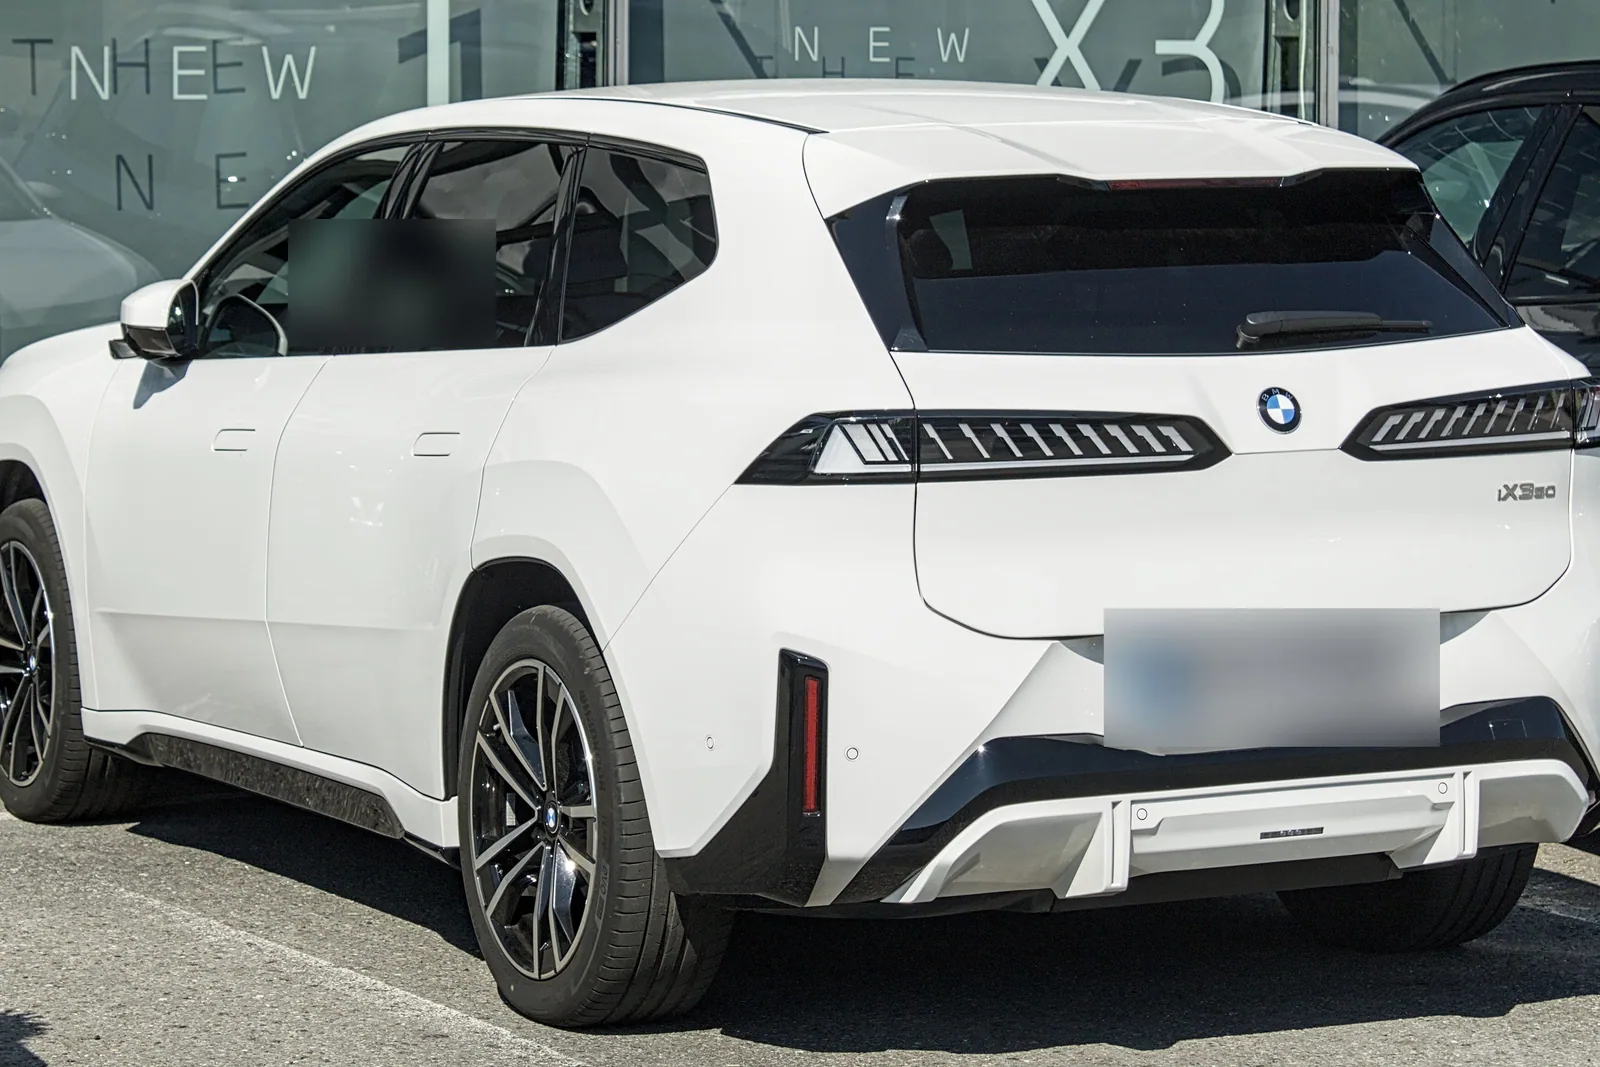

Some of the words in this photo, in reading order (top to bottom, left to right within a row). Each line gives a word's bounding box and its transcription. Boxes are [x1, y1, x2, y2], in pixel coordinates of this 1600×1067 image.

[794, 26, 970, 62] NEW
[1031, 0, 1225, 104] X3
[70, 46, 316, 100] NEW
[115, 152, 250, 211] NE
